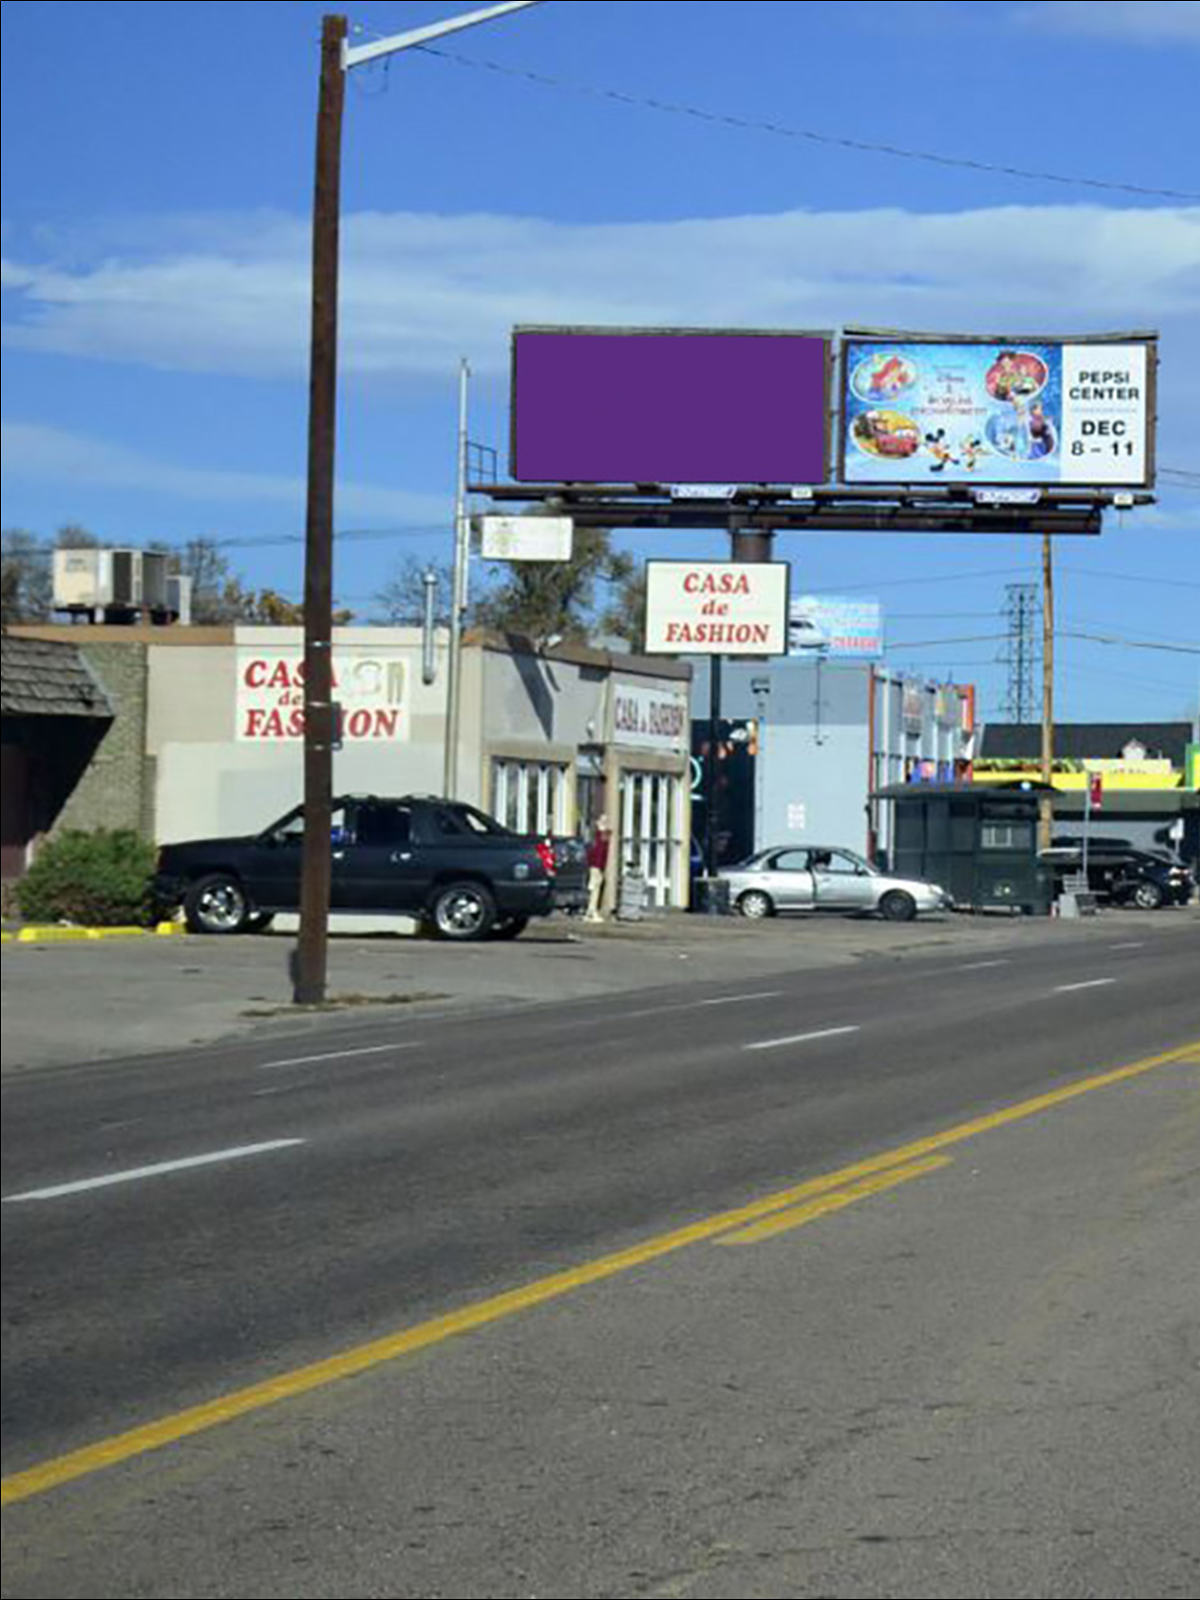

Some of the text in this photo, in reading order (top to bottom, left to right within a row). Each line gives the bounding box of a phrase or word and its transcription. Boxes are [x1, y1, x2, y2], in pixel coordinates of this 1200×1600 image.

[1079, 371, 1129, 384] PEPSI
[1069, 387, 1139, 400] CENTER
[1081, 420, 1126, 436] DEC
[1071, 440, 1084, 456] 8
[1111, 441, 1133, 456] 11
[684, 573, 749, 593] CASA
[702, 599, 728, 615] de
[665, 623, 769, 643] FASHION
[244, 660, 339, 688] CAS
[244, 708, 399, 737] FASION
